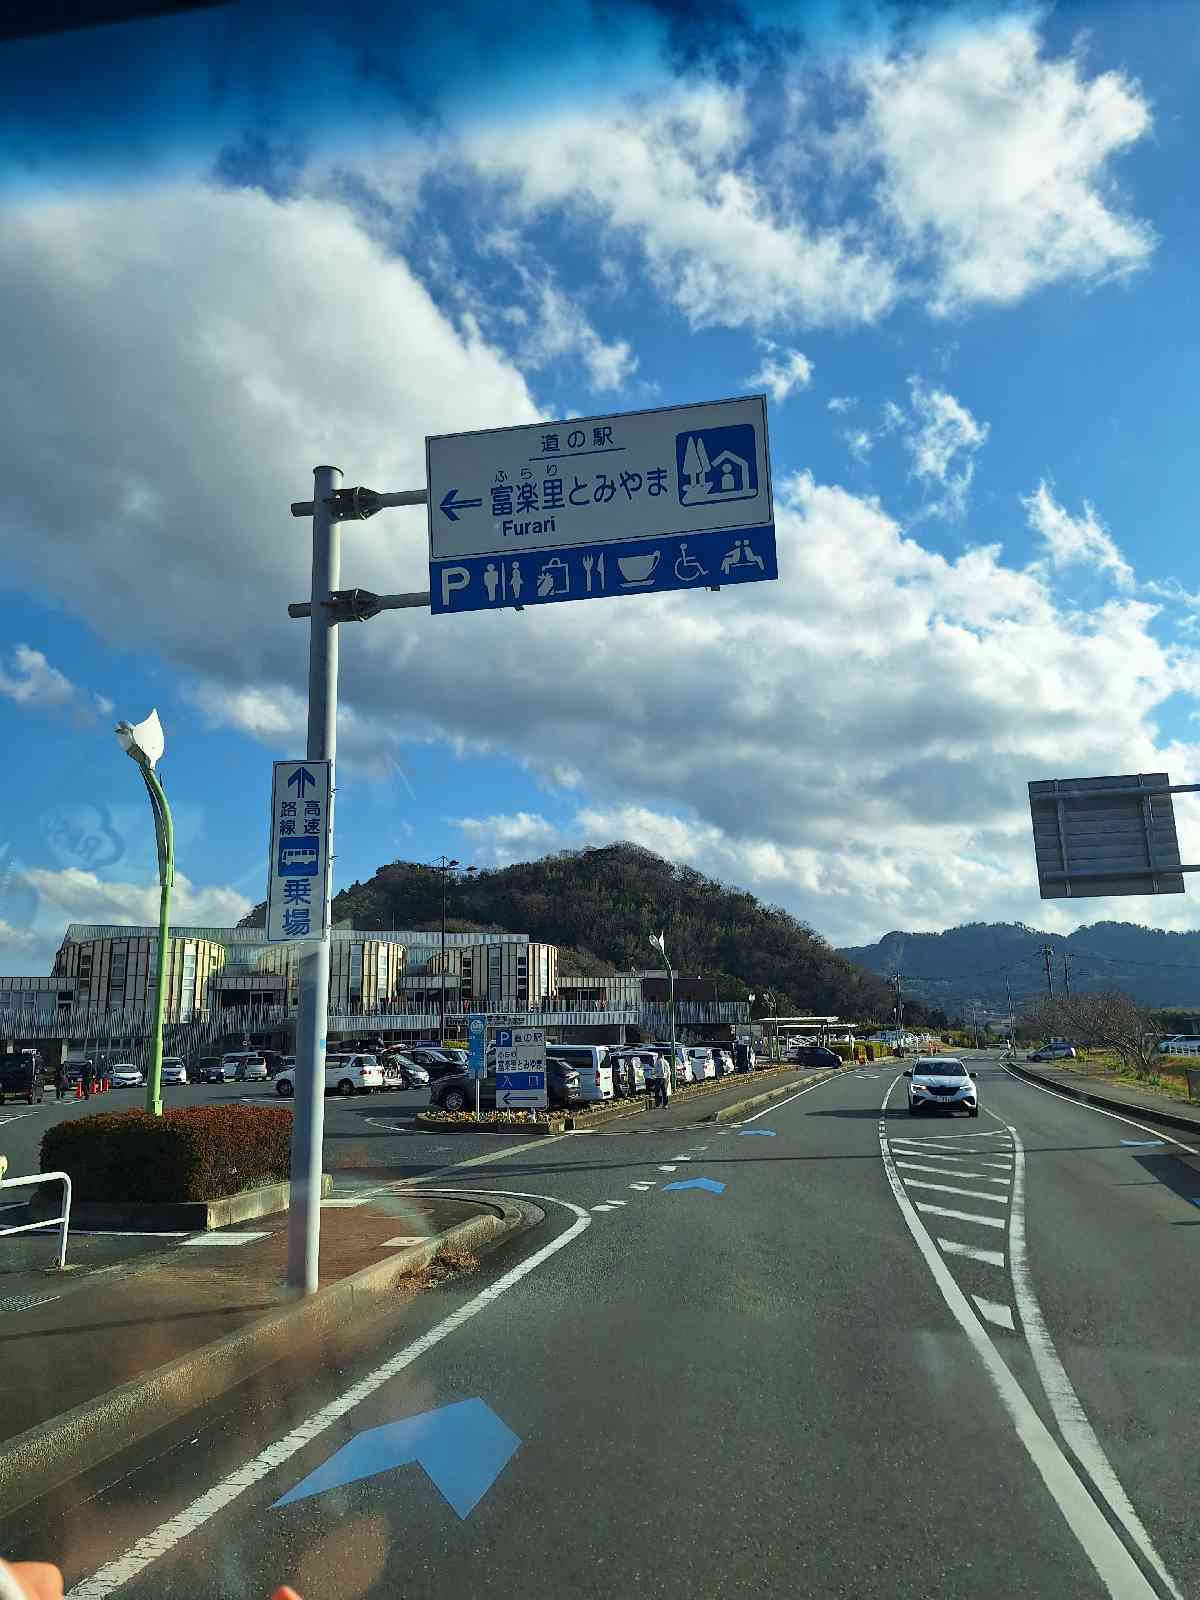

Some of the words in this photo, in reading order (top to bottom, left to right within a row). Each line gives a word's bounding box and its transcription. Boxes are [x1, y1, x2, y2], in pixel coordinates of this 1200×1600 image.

[541, 426, 614, 453] 道の駅
[495, 463, 558, 483] ふらり
[490, 467, 669, 517] 富楽里とみやま
[502, 516, 556, 537] Furari
[441, 567, 471, 607] P
[279, 801, 297, 836] 路線
[303, 800, 321, 834] 高速
[282, 878, 312, 936] 乗場
[500, 1031, 510, 1046] P
